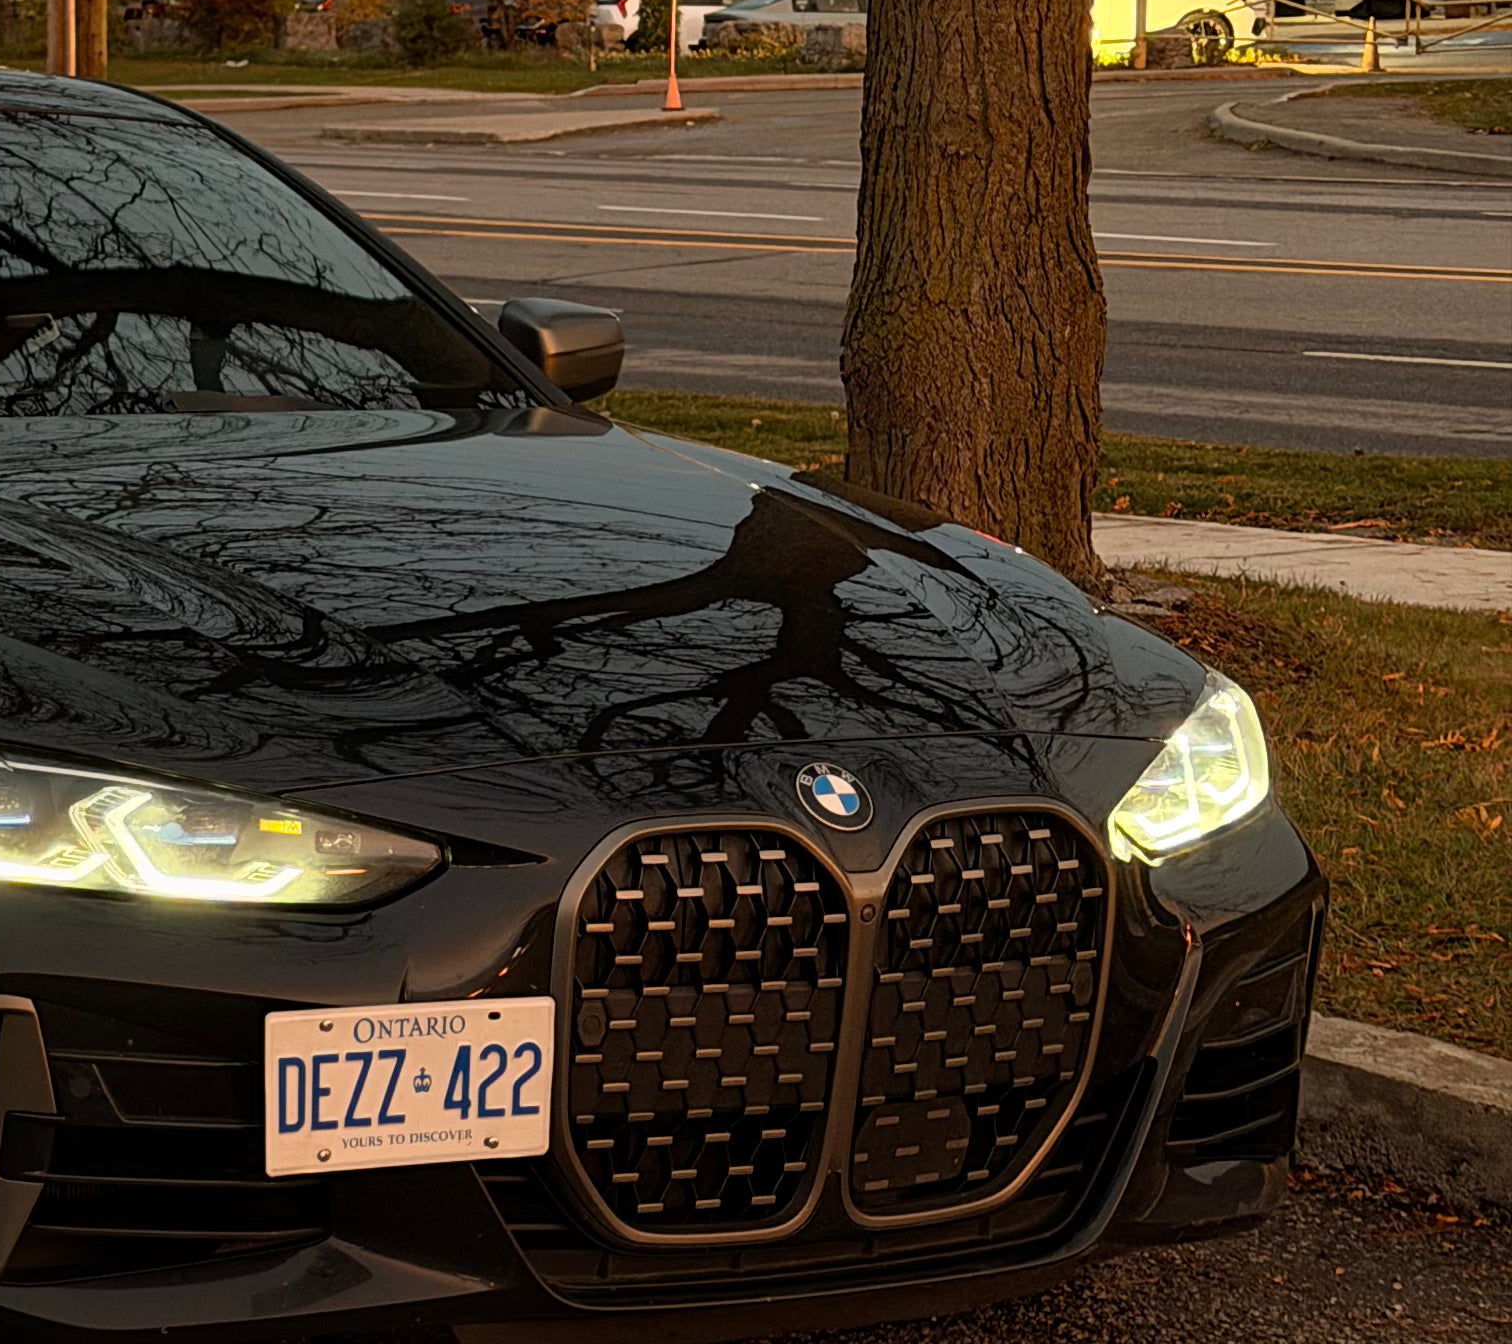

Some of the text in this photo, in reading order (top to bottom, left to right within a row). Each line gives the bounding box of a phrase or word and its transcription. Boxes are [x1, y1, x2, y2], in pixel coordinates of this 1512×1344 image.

[799, 763, 856, 787] BMW
[353, 1014, 466, 1044] ONTARIO
[278, 1041, 543, 1135] DEZZ 422
[341, 1128, 473, 1149] YOURS TO DISCOVER
